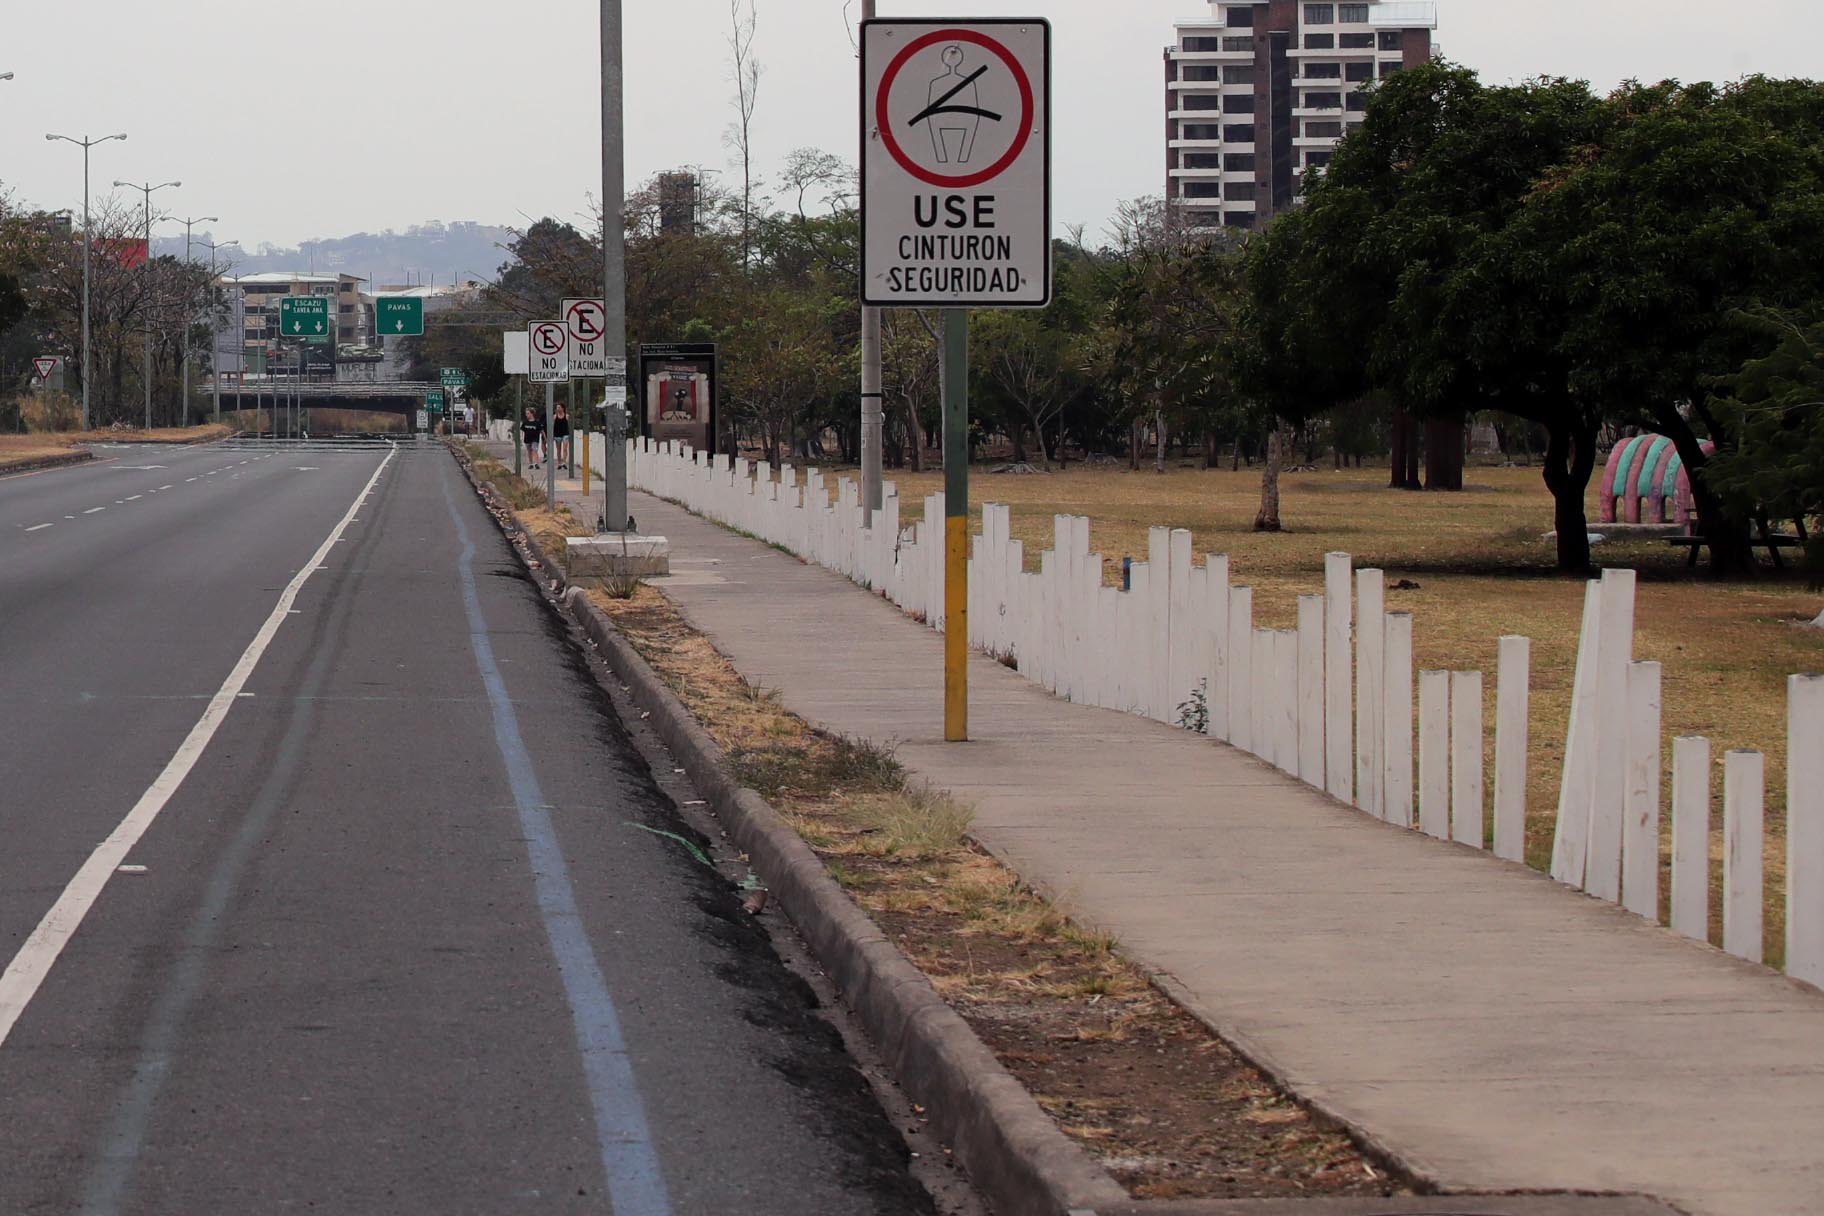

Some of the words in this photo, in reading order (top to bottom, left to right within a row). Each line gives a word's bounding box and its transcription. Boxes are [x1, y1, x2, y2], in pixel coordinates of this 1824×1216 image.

[914, 195, 995, 229] USE
[898, 234, 1011, 261] CINTURON
[889, 266, 1020, 293] SEGURIDAD
[387, 303, 412, 311] PAVAS
[579, 343, 594, 356] NO
[542, 357, 557, 369] NO
[570, 360, 605, 370] STACIONA
